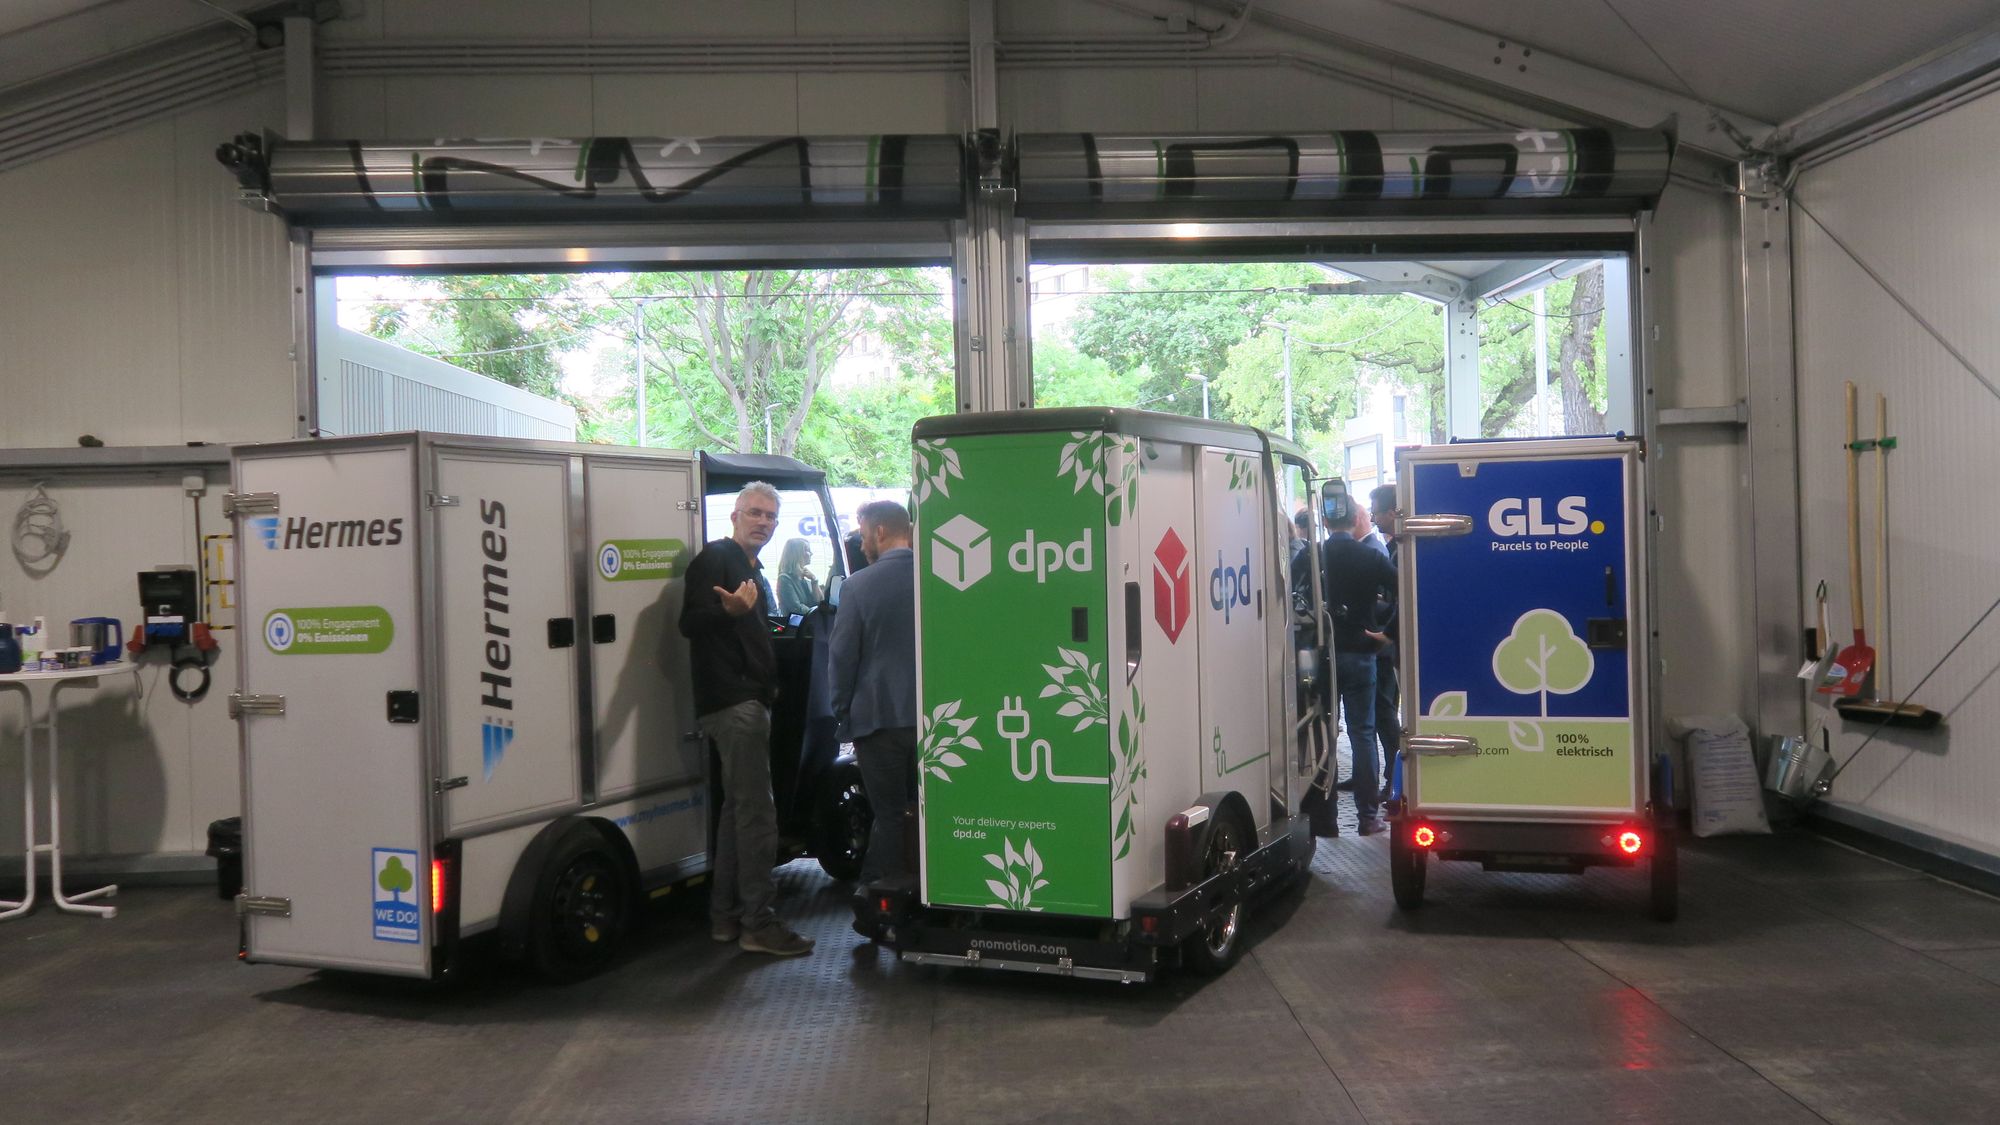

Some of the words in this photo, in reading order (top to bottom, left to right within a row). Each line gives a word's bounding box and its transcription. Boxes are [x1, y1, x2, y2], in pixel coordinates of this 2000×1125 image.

[284, 516, 403, 550] Hermes
[1491, 541, 1532, 551] Parcels
[1535, 541, 1547, 550] to
[1550, 540, 1589, 552] People
[623, 549, 640, 558] 100%
[642, 549, 680, 560] Engagement
[1008, 528, 1093, 583] dpd
[623, 561, 635, 571] 0%
[636, 560, 673, 569] Emissionen
[1209, 547, 1251, 625] dpd
[480, 498, 513, 710] Hermes
[297, 619, 321, 629] 100%
[323, 618, 380, 631] Engagement
[297, 633, 312, 643] 0%
[315, 632, 368, 643] Emissionen
[1556, 734, 1589, 744] 100%
[1556, 747, 1614, 757] elektrisch
[953, 816, 975, 826] Your
[977, 818, 1017, 830] delivery
[1018, 821, 1057, 831] experts
[953, 829, 987, 840] dpd.de
[376, 909, 395, 922] WE
[397, 911, 417, 924] DO!
[970, 939, 1068, 956] onomotion.com
